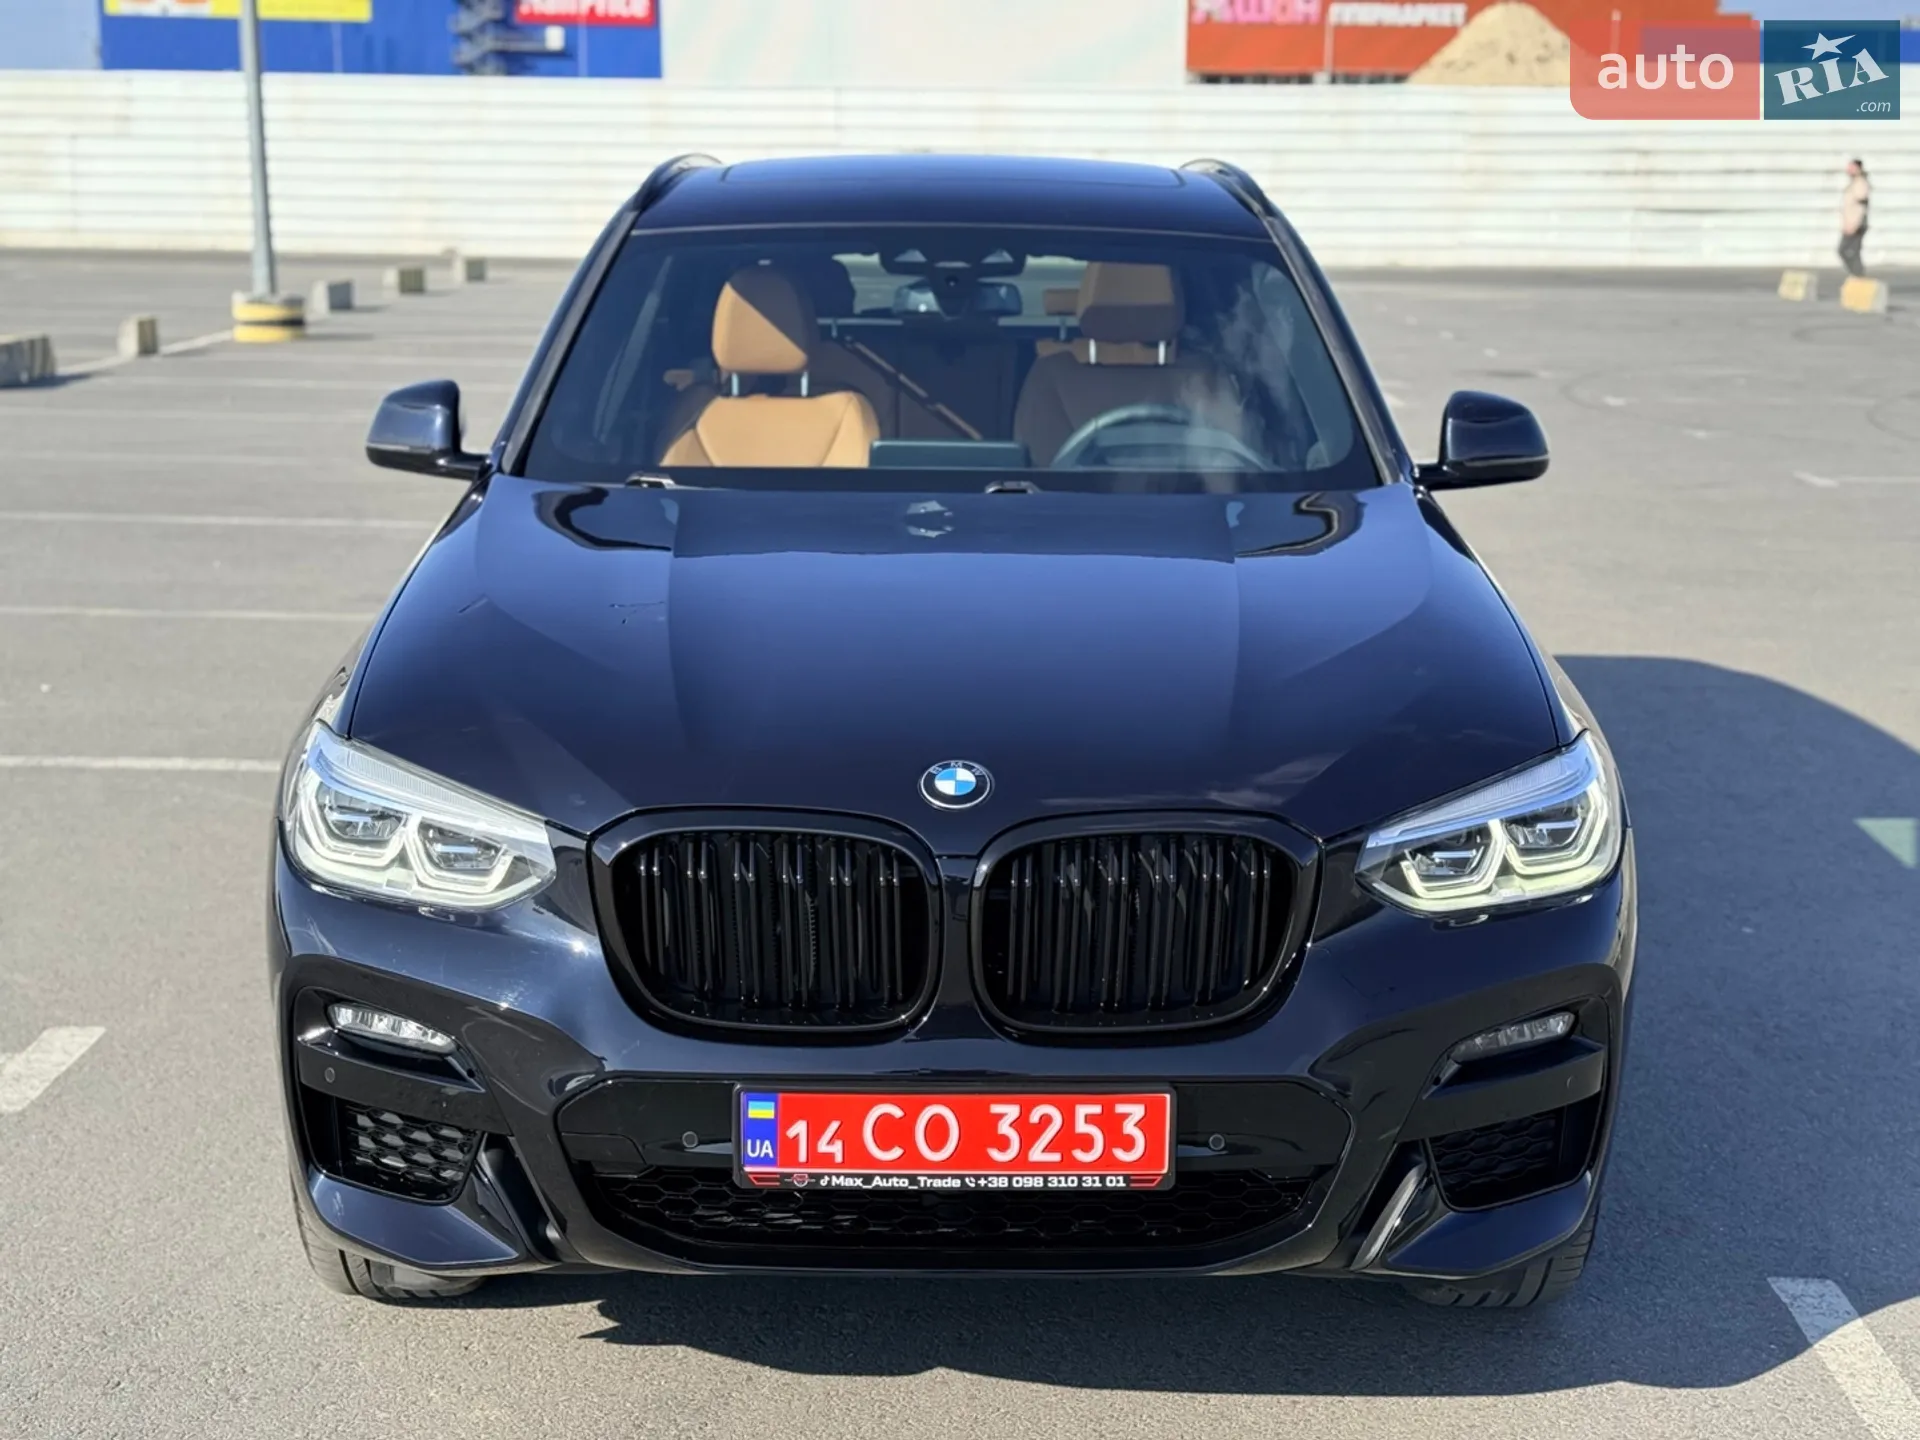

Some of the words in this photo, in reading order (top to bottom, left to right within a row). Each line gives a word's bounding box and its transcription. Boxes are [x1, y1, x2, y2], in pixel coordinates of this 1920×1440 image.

[928, 761, 984, 776] BMW
[785, 1119, 844, 1164] 14
[862, 1103, 960, 1162] CO
[986, 1103, 1147, 1163] 3253
[746, 1139, 774, 1159] UA
[831, 1174, 961, 1190] Max_Auto_Trade
[977, 1175, 1008, 1189] +38
[1011, 1175, 1044, 1189] 098
[1047, 1175, 1079, 1189] 310
[1081, 1175, 1103, 1189] 31
[1105, 1175, 1127, 1189] 01
